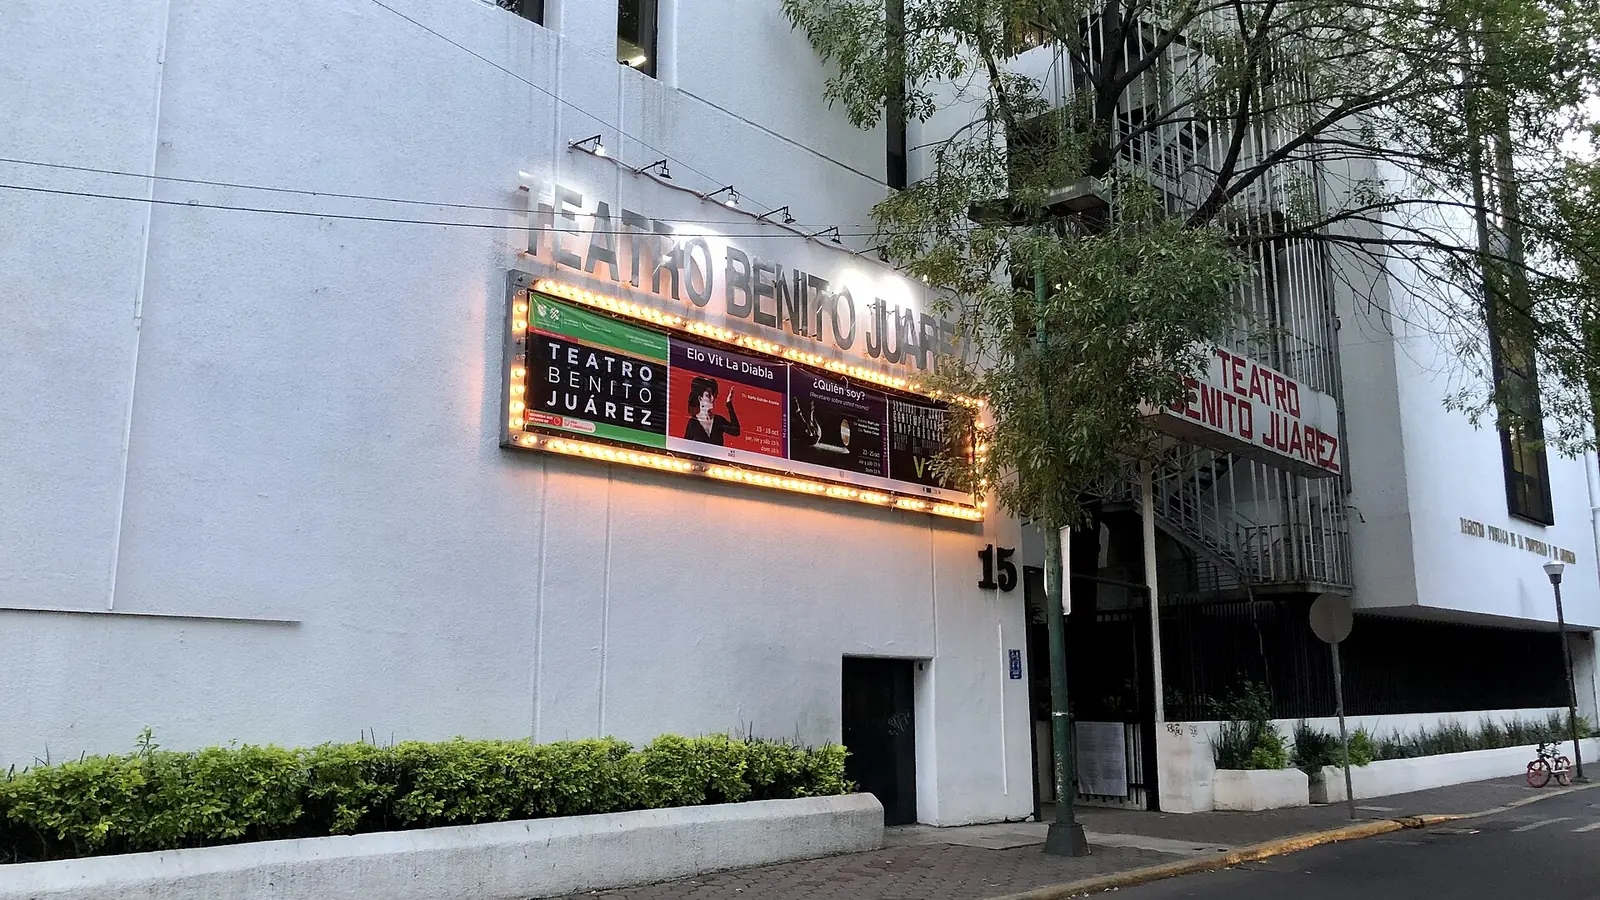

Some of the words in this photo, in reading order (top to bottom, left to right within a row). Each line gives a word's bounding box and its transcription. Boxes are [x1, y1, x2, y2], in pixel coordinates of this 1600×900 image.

[519, 171, 712, 307] TEATRO
[726, 246, 856, 350] BENITO
[548, 342, 653, 382] TEATRO
[687, 348, 705, 361] Elo
[707, 352, 723, 367] Vit
[726, 358, 739, 371] La
[741, 362, 774, 380] Diabla
[548, 366, 652, 404] BENITO
[813, 378, 845, 395] ¿Quién
[846, 388, 866, 401] soy?
[1216, 349, 1301, 419] TEATRO
[546, 389, 652, 426] JUÁREZ
[1262, 411, 1340, 472] JUAREZ
[978, 543, 1018, 592] 15
